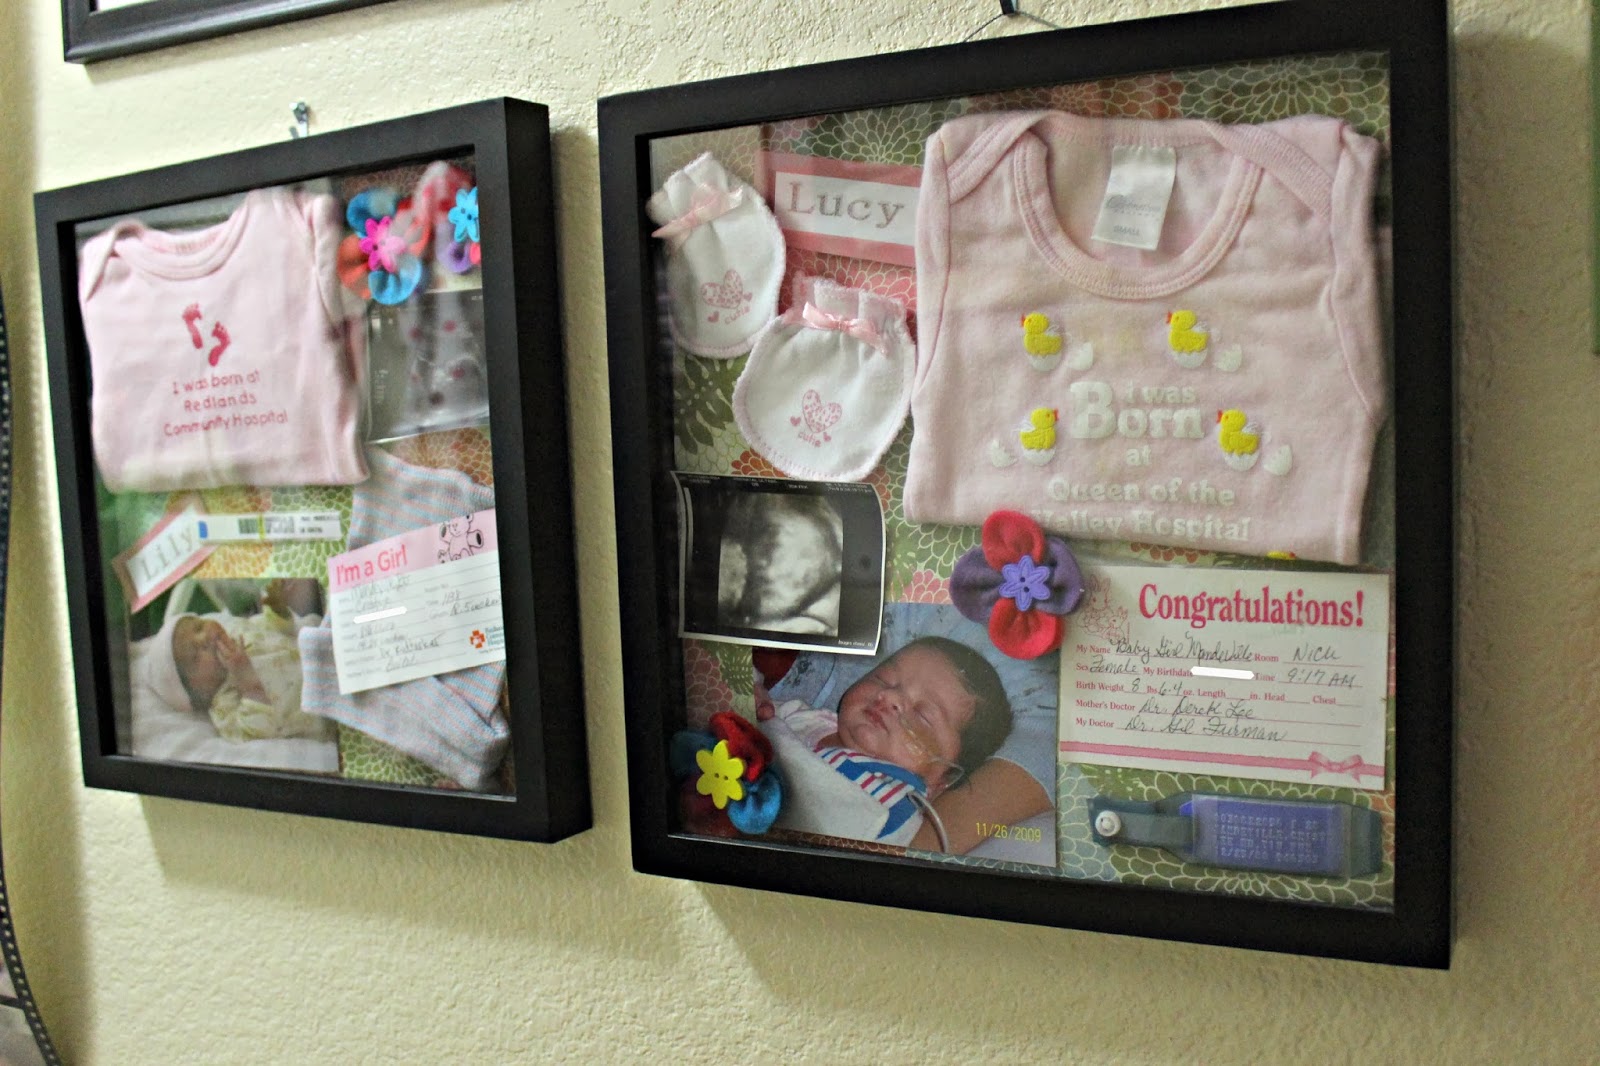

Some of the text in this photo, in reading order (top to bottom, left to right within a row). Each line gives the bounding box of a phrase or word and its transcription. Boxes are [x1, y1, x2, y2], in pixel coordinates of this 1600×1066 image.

[788, 181, 904, 229] Lucy
[173, 381, 179, 394] I
[211, 372, 243, 387] born
[247, 369, 260, 383] at
[184, 391, 257, 411] Redlands
[1142, 384, 1197, 404] was
[232, 409, 288, 428] Hospital
[1070, 381, 1206, 439] Born
[1126, 445, 1152, 467] at
[1048, 474, 1235, 506] Queen of the
[1130, 509, 1252, 541] Hospital
[140, 525, 194, 583] Lily
[336, 544, 408, 586] I'm a Girl
[1139, 584, 1364, 629] Congratulations!
[1076, 644, 1111, 654] My Name
[1254, 653, 1279, 662] Room
[1089, 655, 1138, 675] Female
[1143, 667, 1155, 676] My
[1076, 681, 1124, 693] Birth Weight
[1131, 678, 1141, 692] 8
[1075, 700, 1135, 711] Mother's Doctor
[1198, 689, 1226, 701] Length
[1264, 692, 1285, 701] Head
[1312, 695, 1337, 705] Chest
[1075, 717, 1114, 728] My Doctor
